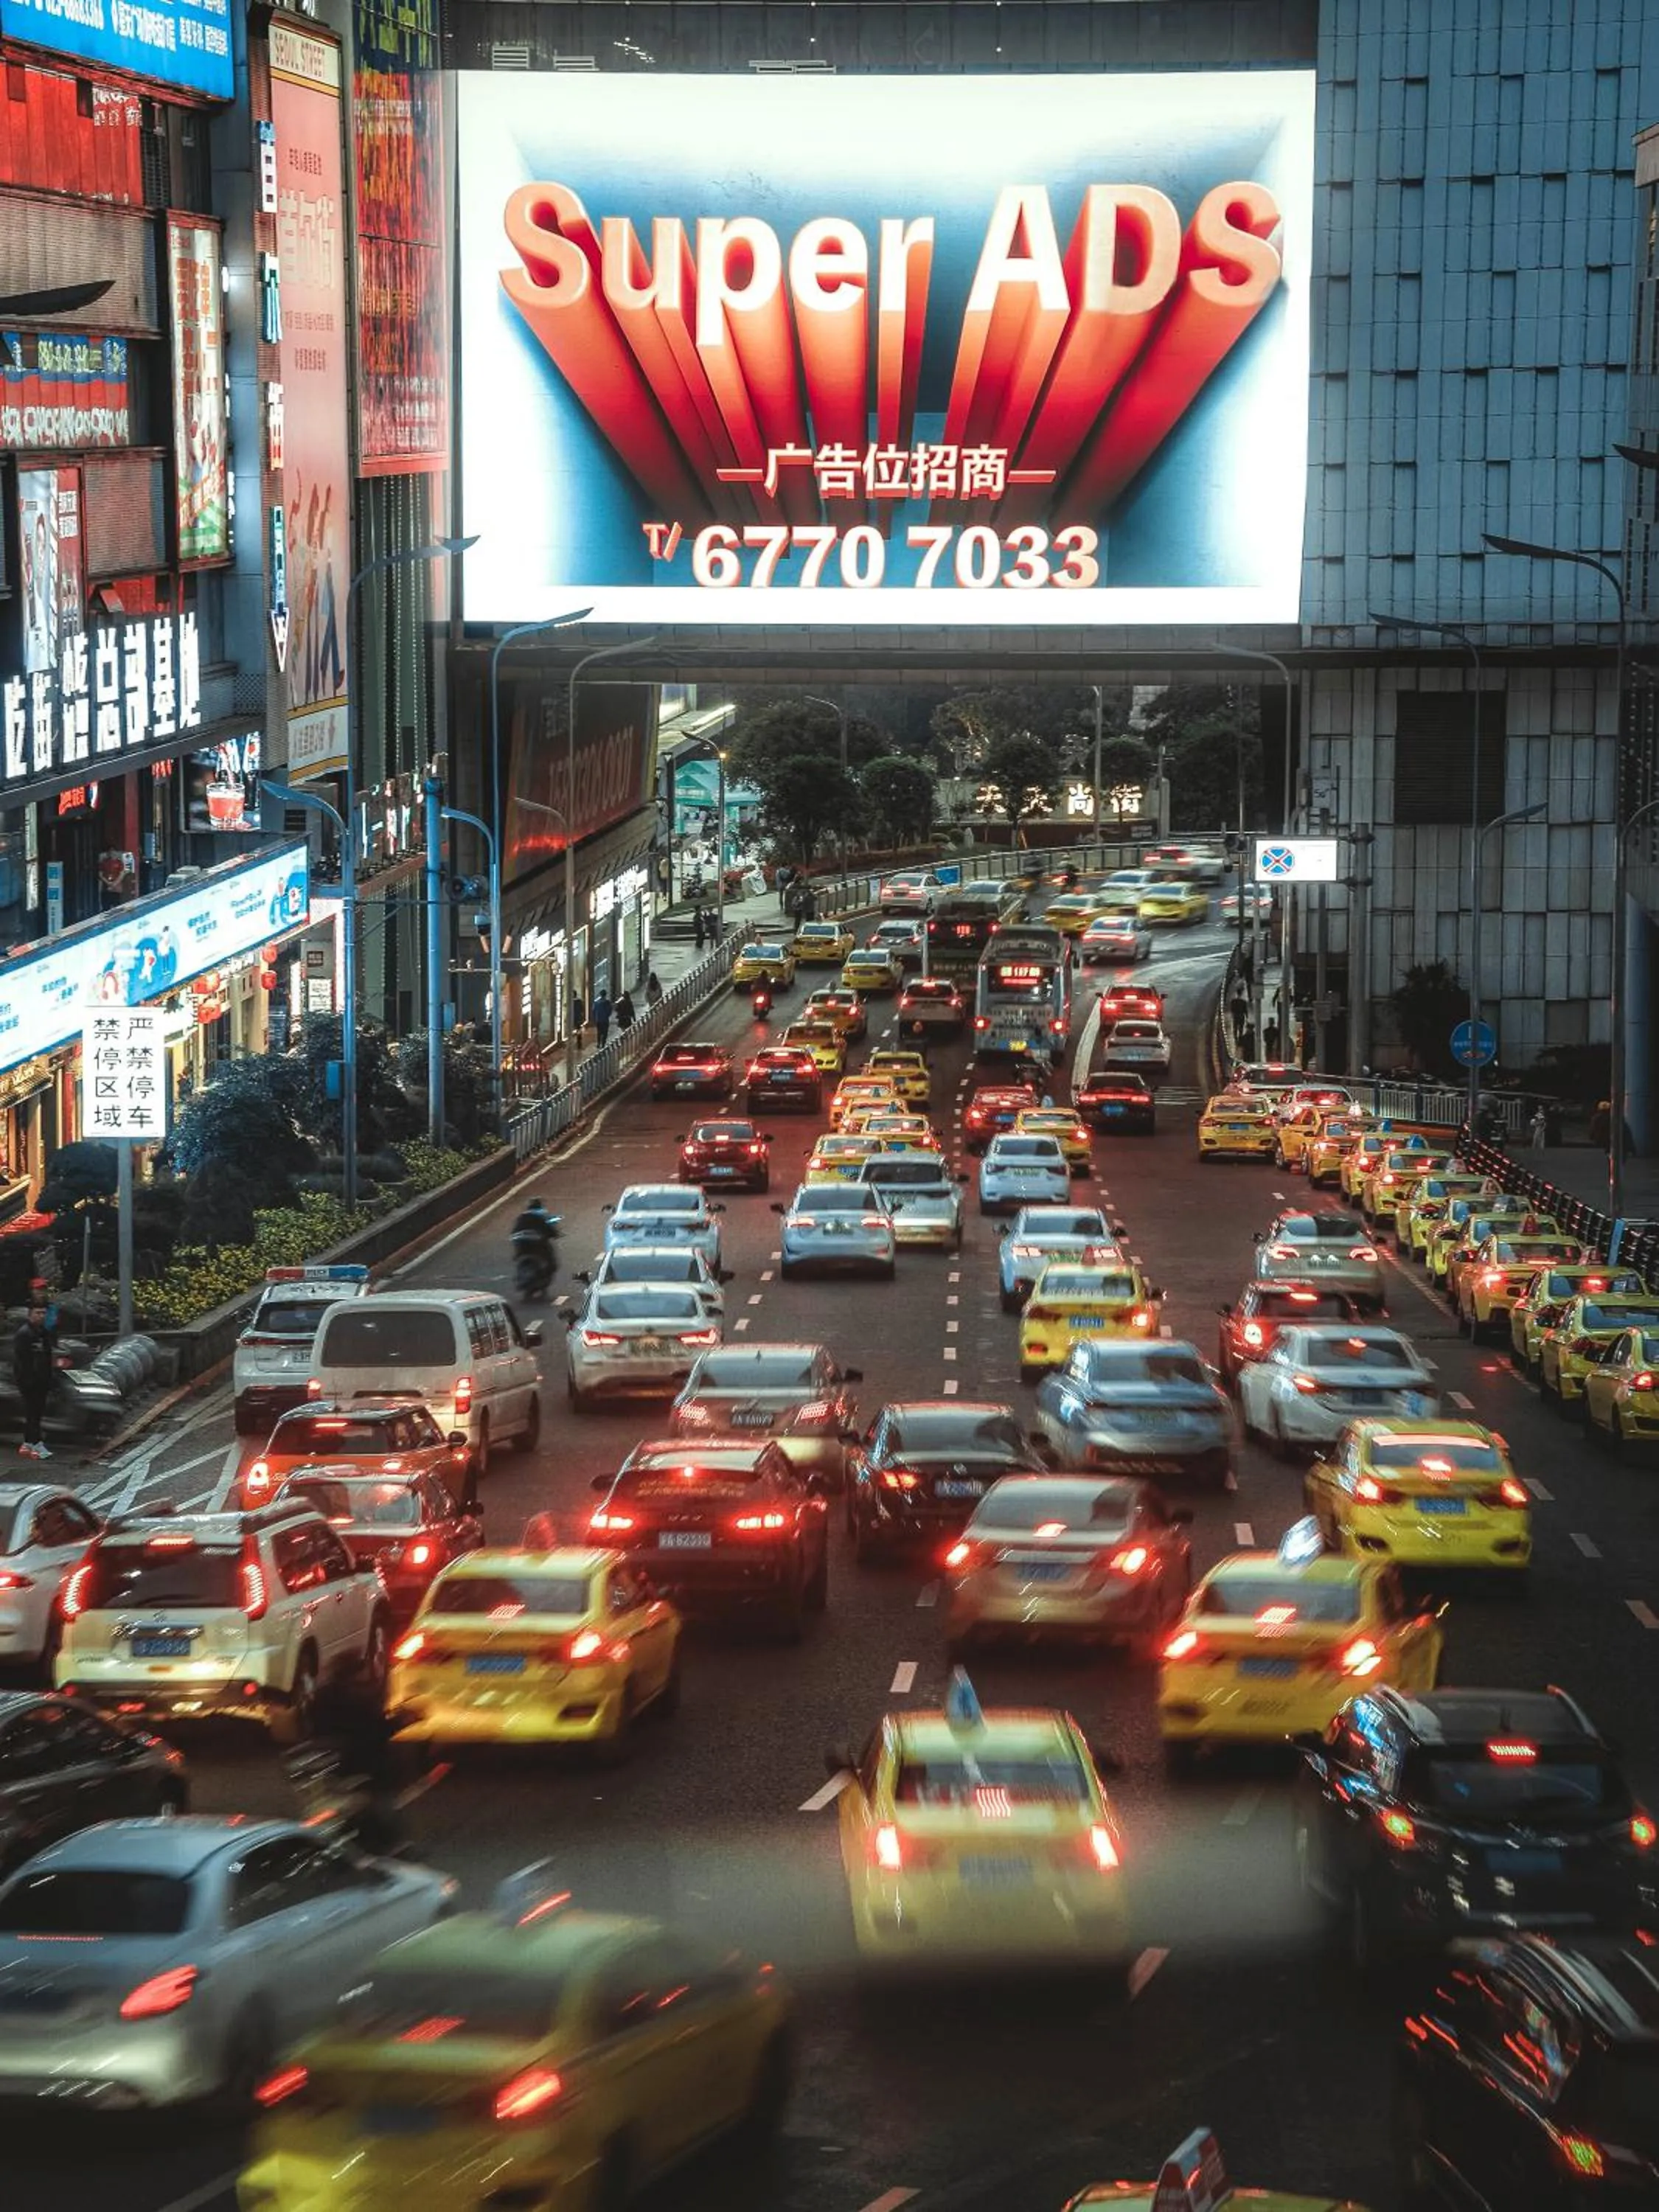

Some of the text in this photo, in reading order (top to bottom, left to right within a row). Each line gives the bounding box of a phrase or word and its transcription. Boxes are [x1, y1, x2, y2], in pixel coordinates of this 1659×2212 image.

[498, 180, 1281, 347] Super ADS
[692, 525, 886, 588] 6770
[906, 525, 1099, 588] 7033
[94, 1018, 122, 1127] 禁停区域
[127, 1017, 155, 1129] 严禁停车
